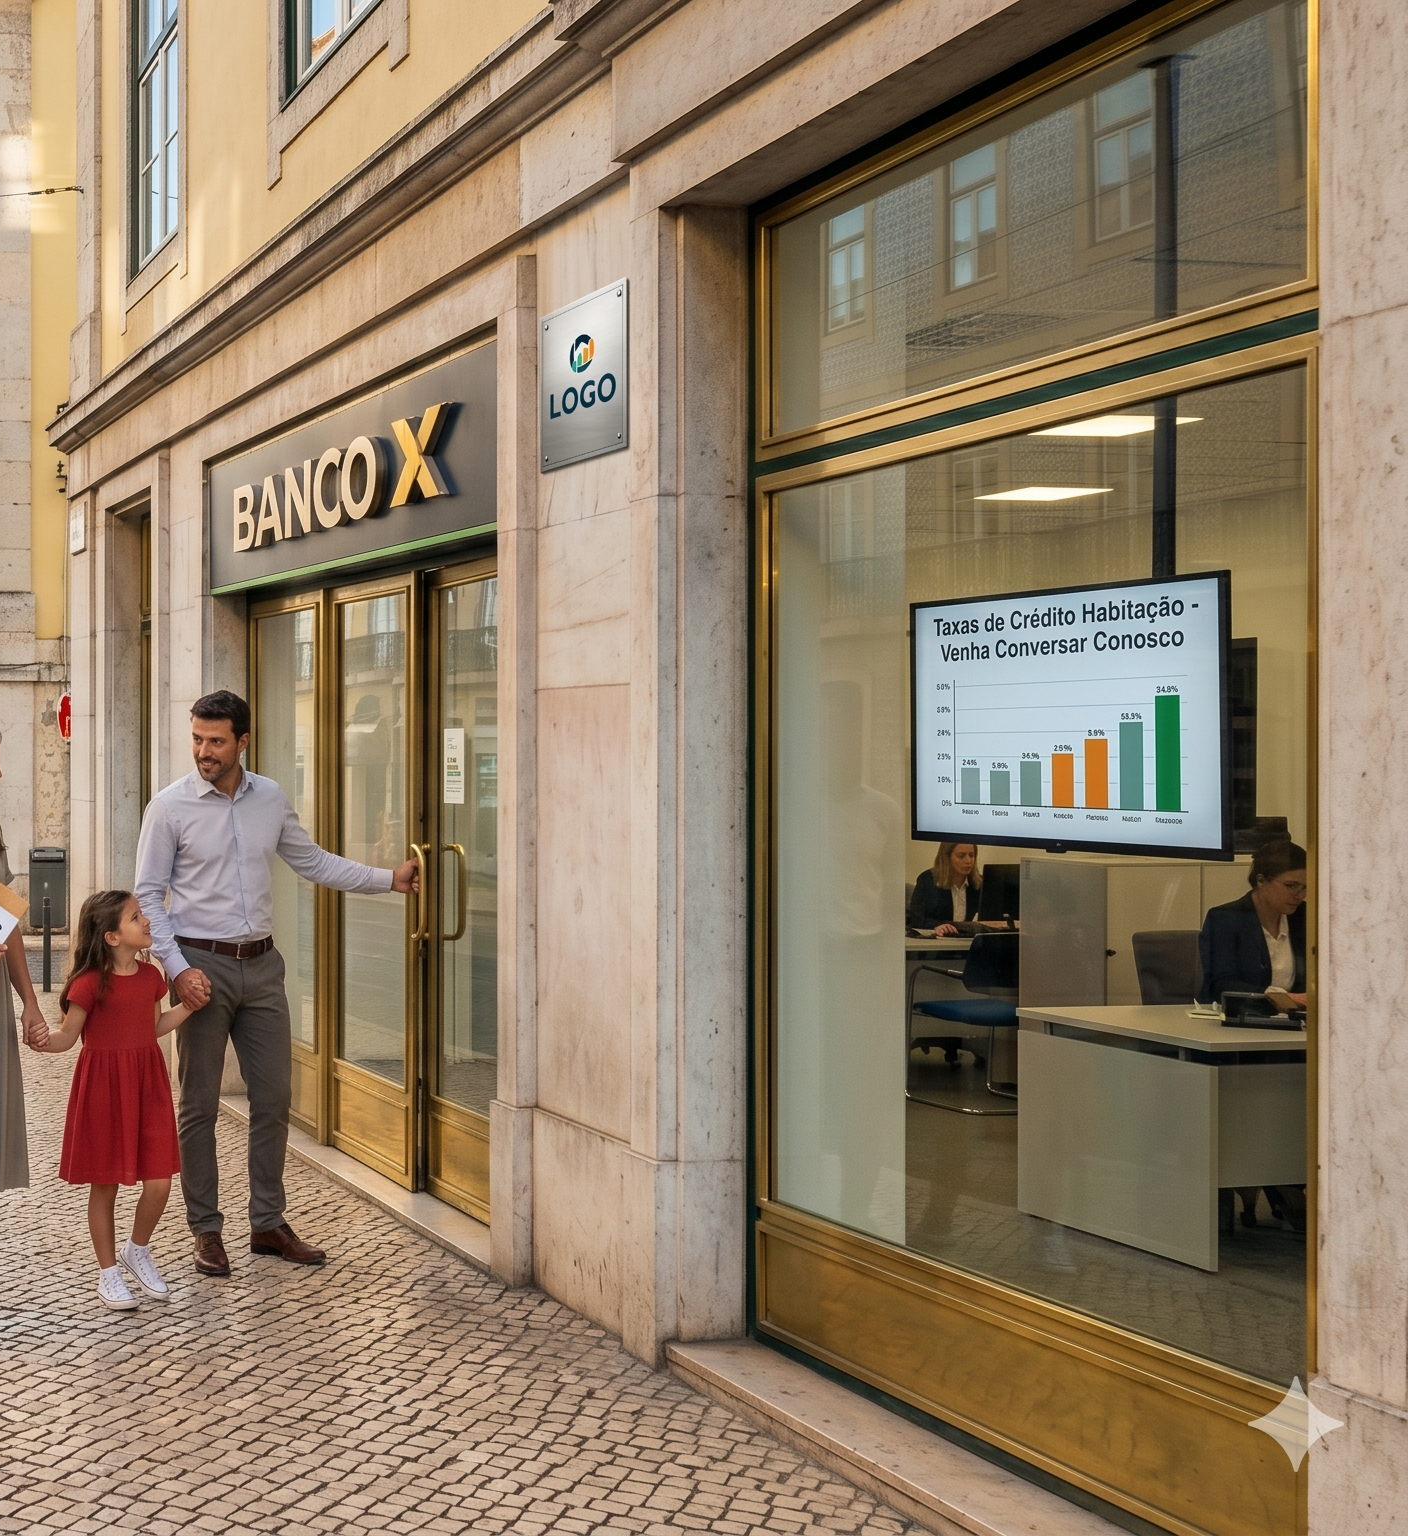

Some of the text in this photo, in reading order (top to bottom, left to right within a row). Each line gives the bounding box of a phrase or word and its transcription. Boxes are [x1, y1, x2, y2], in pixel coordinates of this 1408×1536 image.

[549, 373, 617, 419] LOGO
[233, 401, 454, 553] BANCO X
[933, 618, 980, 637] Taxas
[984, 612, 1005, 632] de
[1010, 607, 1076, 630] Crédito
[1082, 596, 1185, 623] Habitação
[940, 630, 1185, 662] Venha Conversar Conosco
